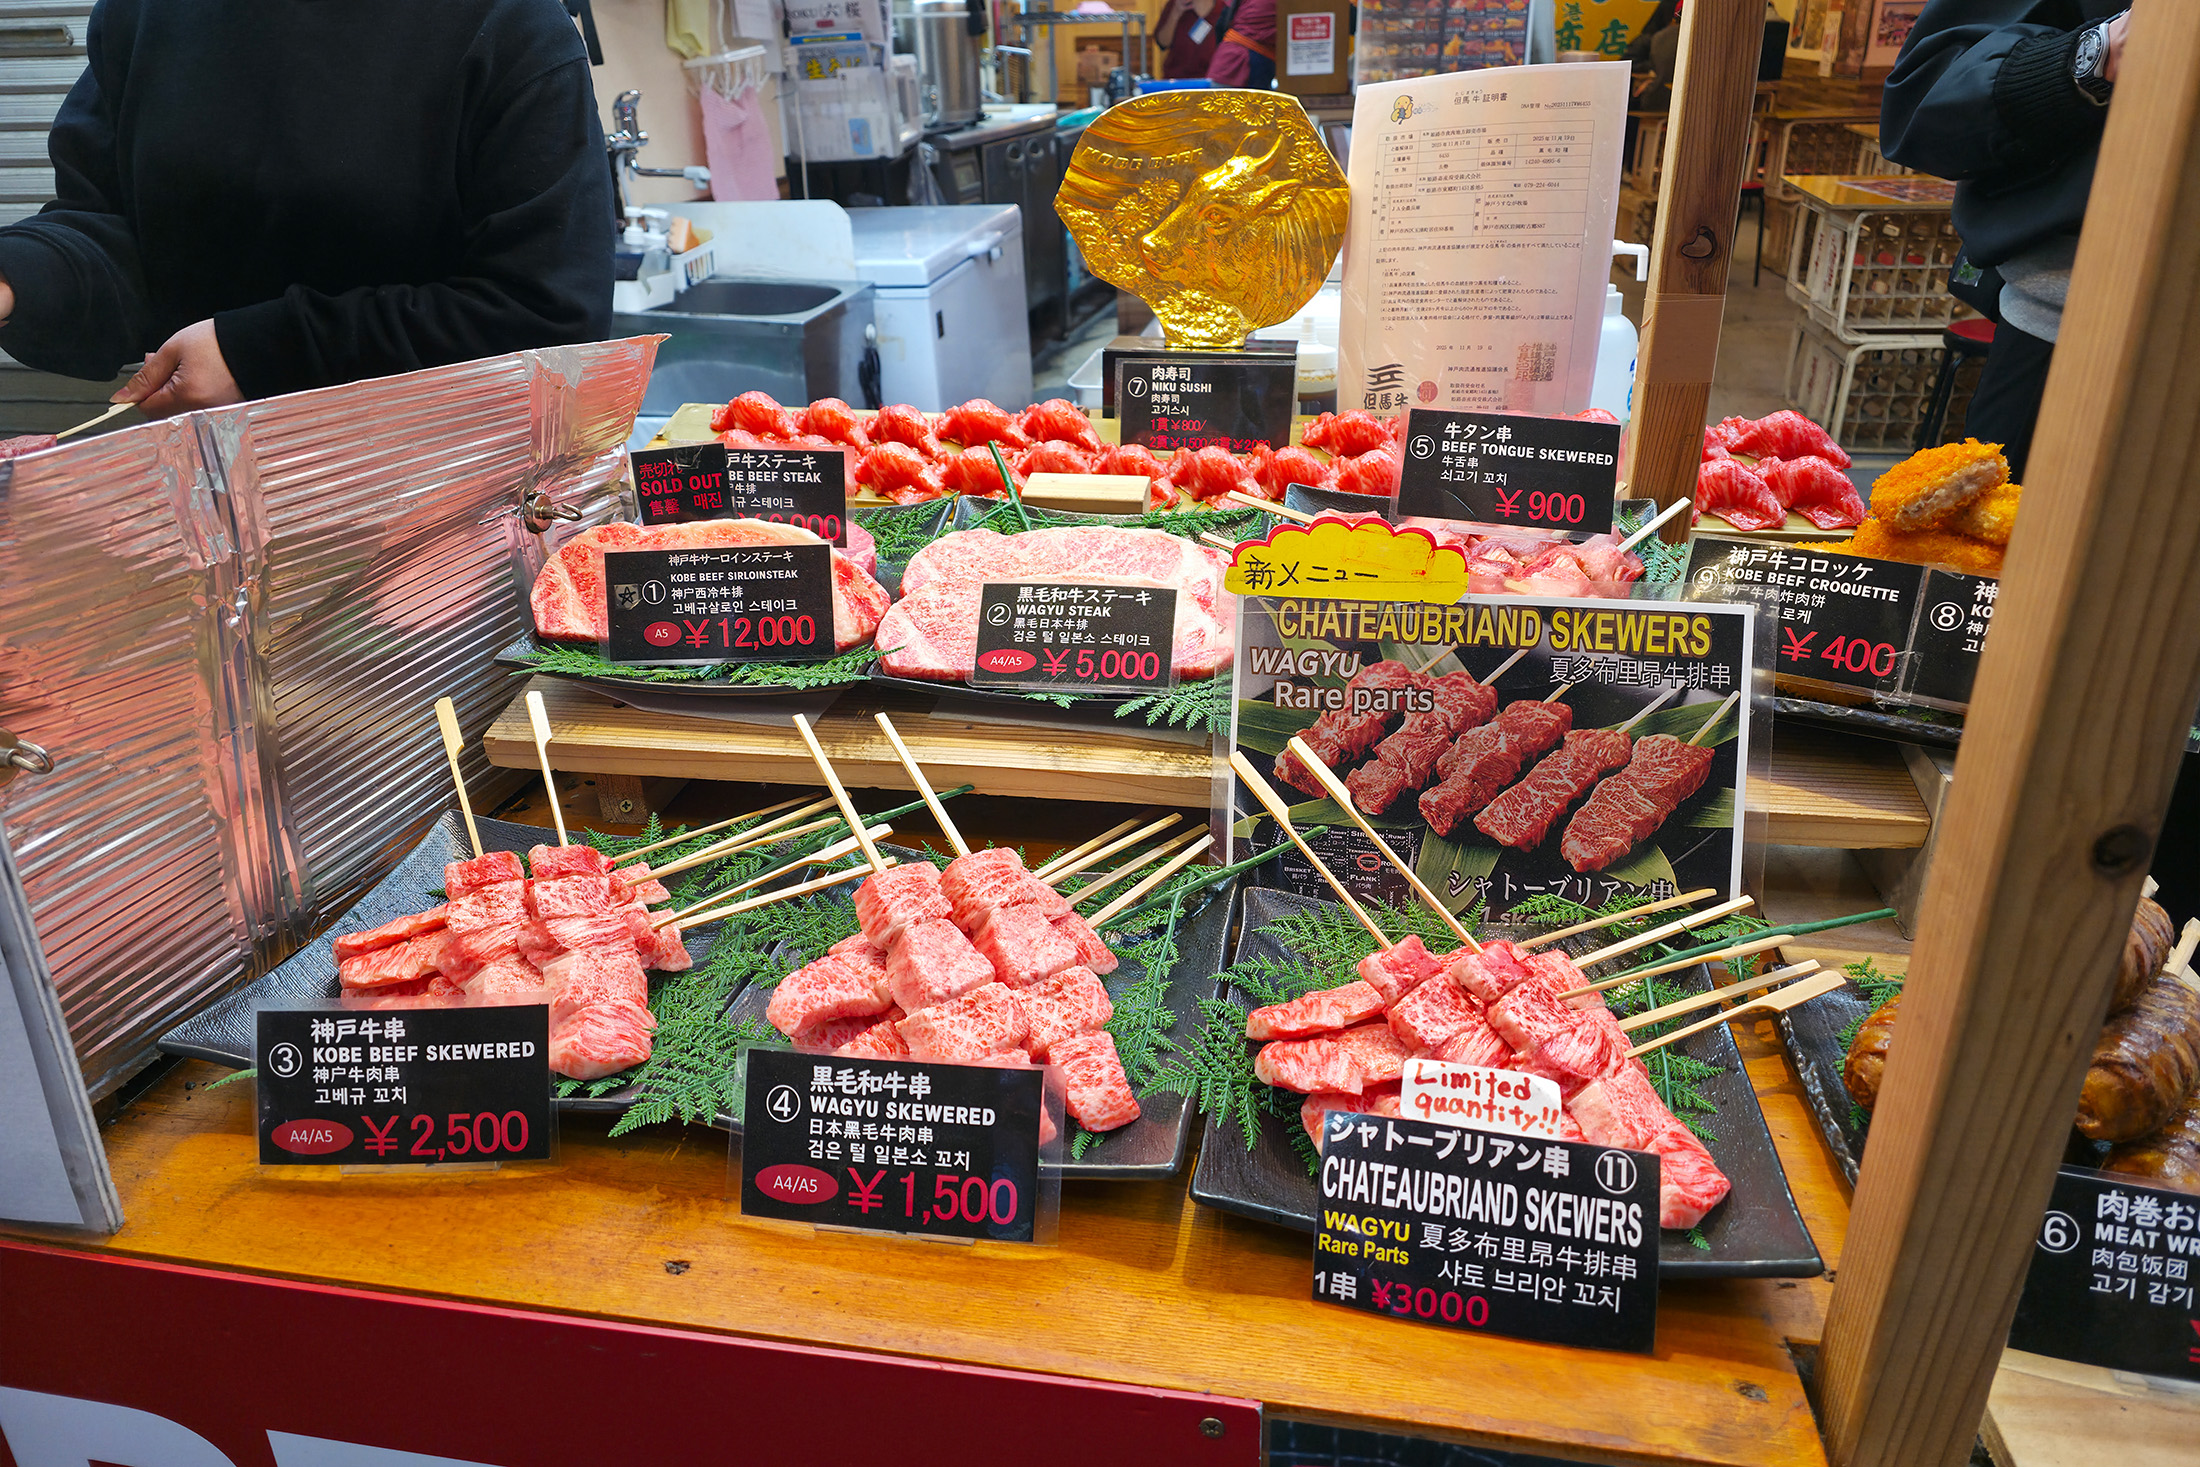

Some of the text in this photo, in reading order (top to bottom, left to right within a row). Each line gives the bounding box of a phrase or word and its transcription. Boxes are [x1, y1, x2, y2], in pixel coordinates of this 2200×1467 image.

[1482, 93, 1508, 102] 証明書
[1081, 146, 1203, 170] KOBE BEEF
[1152, 366, 1191, 381] 肉寿司
[1151, 394, 1180, 404] 肉寿司
[1152, 382, 1212, 393] NIKU SUSHI
[1151, 406, 1190, 416] 고기스시
[1444, 422, 1512, 443] 牛タン串
[1442, 441, 1614, 466] BEEF TONGUE SKEWERED
[1442, 455, 1479, 468] 牛舌串
[641, 473, 722, 497] SOLD OUT
[748, 471, 778, 482] BEEF
[783, 472, 822, 483] STEAK
[1440, 469, 1508, 486] 쇠고기 꼬치
[649, 499, 680, 517] 售罄
[694, 491, 723, 510] 매진
[750, 497, 794, 508] 스테이크
[668, 551, 794, 566] 神戸牛サーロインステーキ
[1727, 546, 1873, 581] 神戸牛コロッケ
[670, 570, 798, 583] KOBE BEEF SIRLOINSTEAK
[1242, 554, 1380, 591] 新メニュー
[1725, 567, 1900, 602] KOBE BEEF CROQUETTE
[673, 599, 797, 615] 고베규살로인 스테이크
[1016, 586, 1152, 606] 黒毛和牛ステーキ
[1016, 605, 1112, 617] WAGYU STEAK
[655, 629, 668, 638] A5
[1013, 630, 1037, 643] 검은
[1059, 631, 1096, 644] 일본소
[1100, 633, 1151, 646] 스테이크
[1278, 599, 1713, 656] CHATEAUBRIAND SKEWERS
[990, 656, 1022, 666] A4/A5
[1250, 648, 1361, 679] WAGYU
[1550, 655, 1732, 688] 夏多布里昂牛排串
[1274, 680, 1435, 714] Rare parts
[310, 1017, 406, 1044] 神戸牛串
[313, 1041, 535, 1064] KOBE BEEF SKEWERED
[810, 1065, 932, 1100] 黒毛和牛串
[1414, 1062, 1532, 1101] Limited
[315, 1086, 407, 1106] 고베규 꼬치
[809, 1096, 996, 1127] WAGYU SKEWERED
[1415, 1092, 1559, 1135] quantity!!
[290, 1129, 334, 1143] A4/A5
[1329, 1113, 1570, 1179] シャトーブリアン串
[808, 1139, 971, 1172] 검은 털 일본소 꼬치
[773, 1175, 818, 1194] A4/A5
[1322, 1154, 1643, 1248] CHATEAUBRIAND SKEWERS
[1324, 1210, 1410, 1242] WAGYU
[2095, 1222, 2160, 1249] MEAT
[1318, 1232, 1410, 1266] Rare Parts
[1419, 1221, 1638, 1282] 夏多布里昂牛排串
[2092, 1247, 2189, 1280] 肉包饭团
[1314, 1270, 1489, 1327] 1串 ¥3000
[1438, 1259, 1621, 1314] 샤토 브리안 꼬치
[2089, 1273, 2136, 1300] 고기
